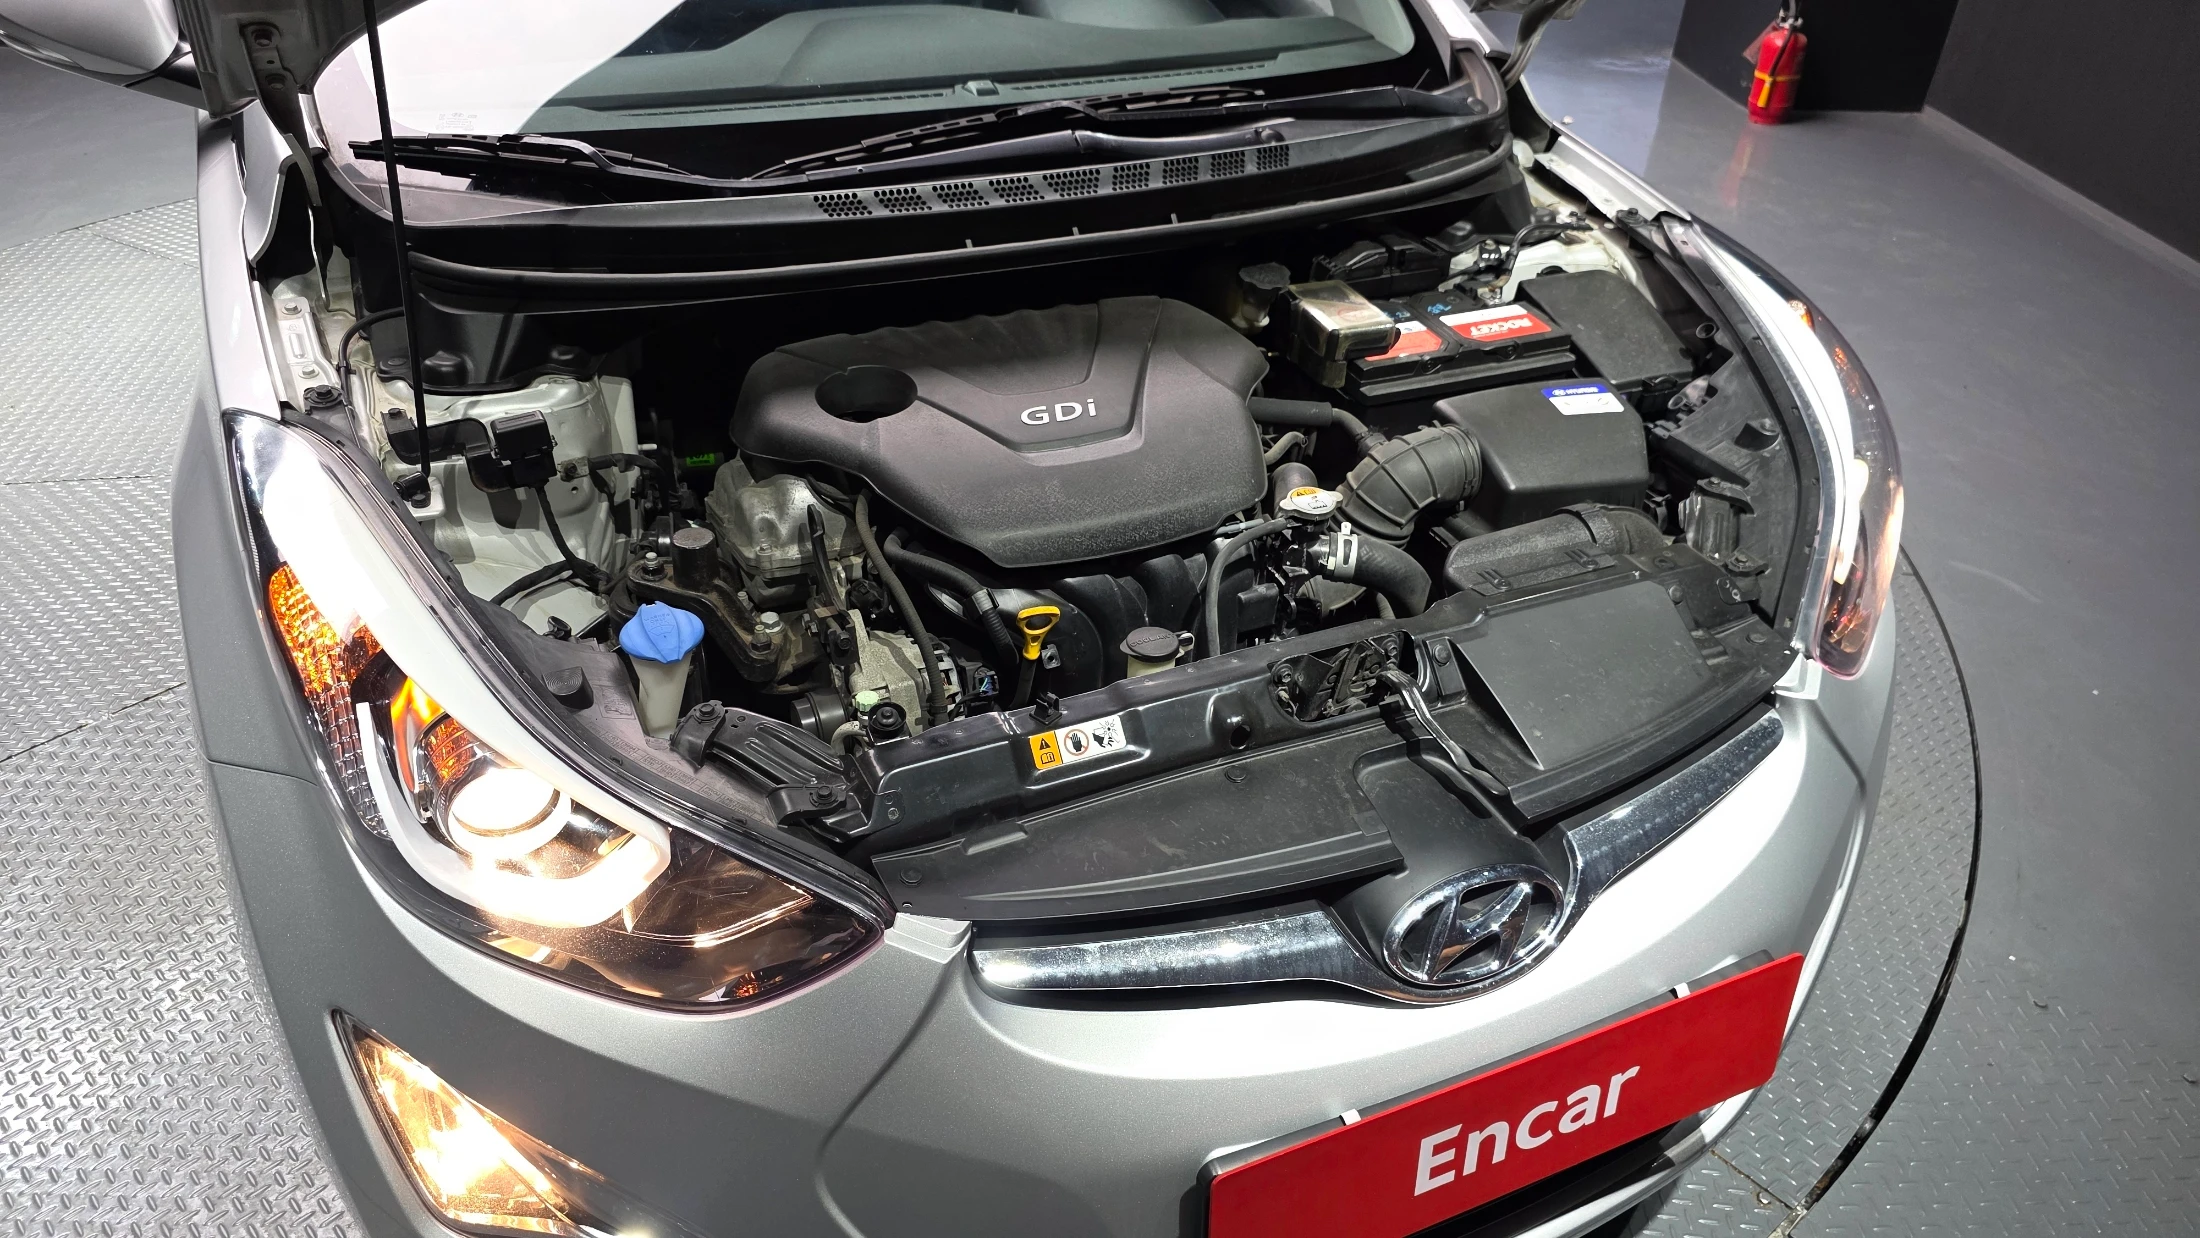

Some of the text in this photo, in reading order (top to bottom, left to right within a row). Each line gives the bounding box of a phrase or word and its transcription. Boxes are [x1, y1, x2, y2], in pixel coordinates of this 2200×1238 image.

[1470, 318, 1532, 336] ROCKET
[1020, 398, 1097, 426] GDi
[1129, 633, 1176, 648] COOLANT
[1413, 1065, 1641, 1197] Encar
